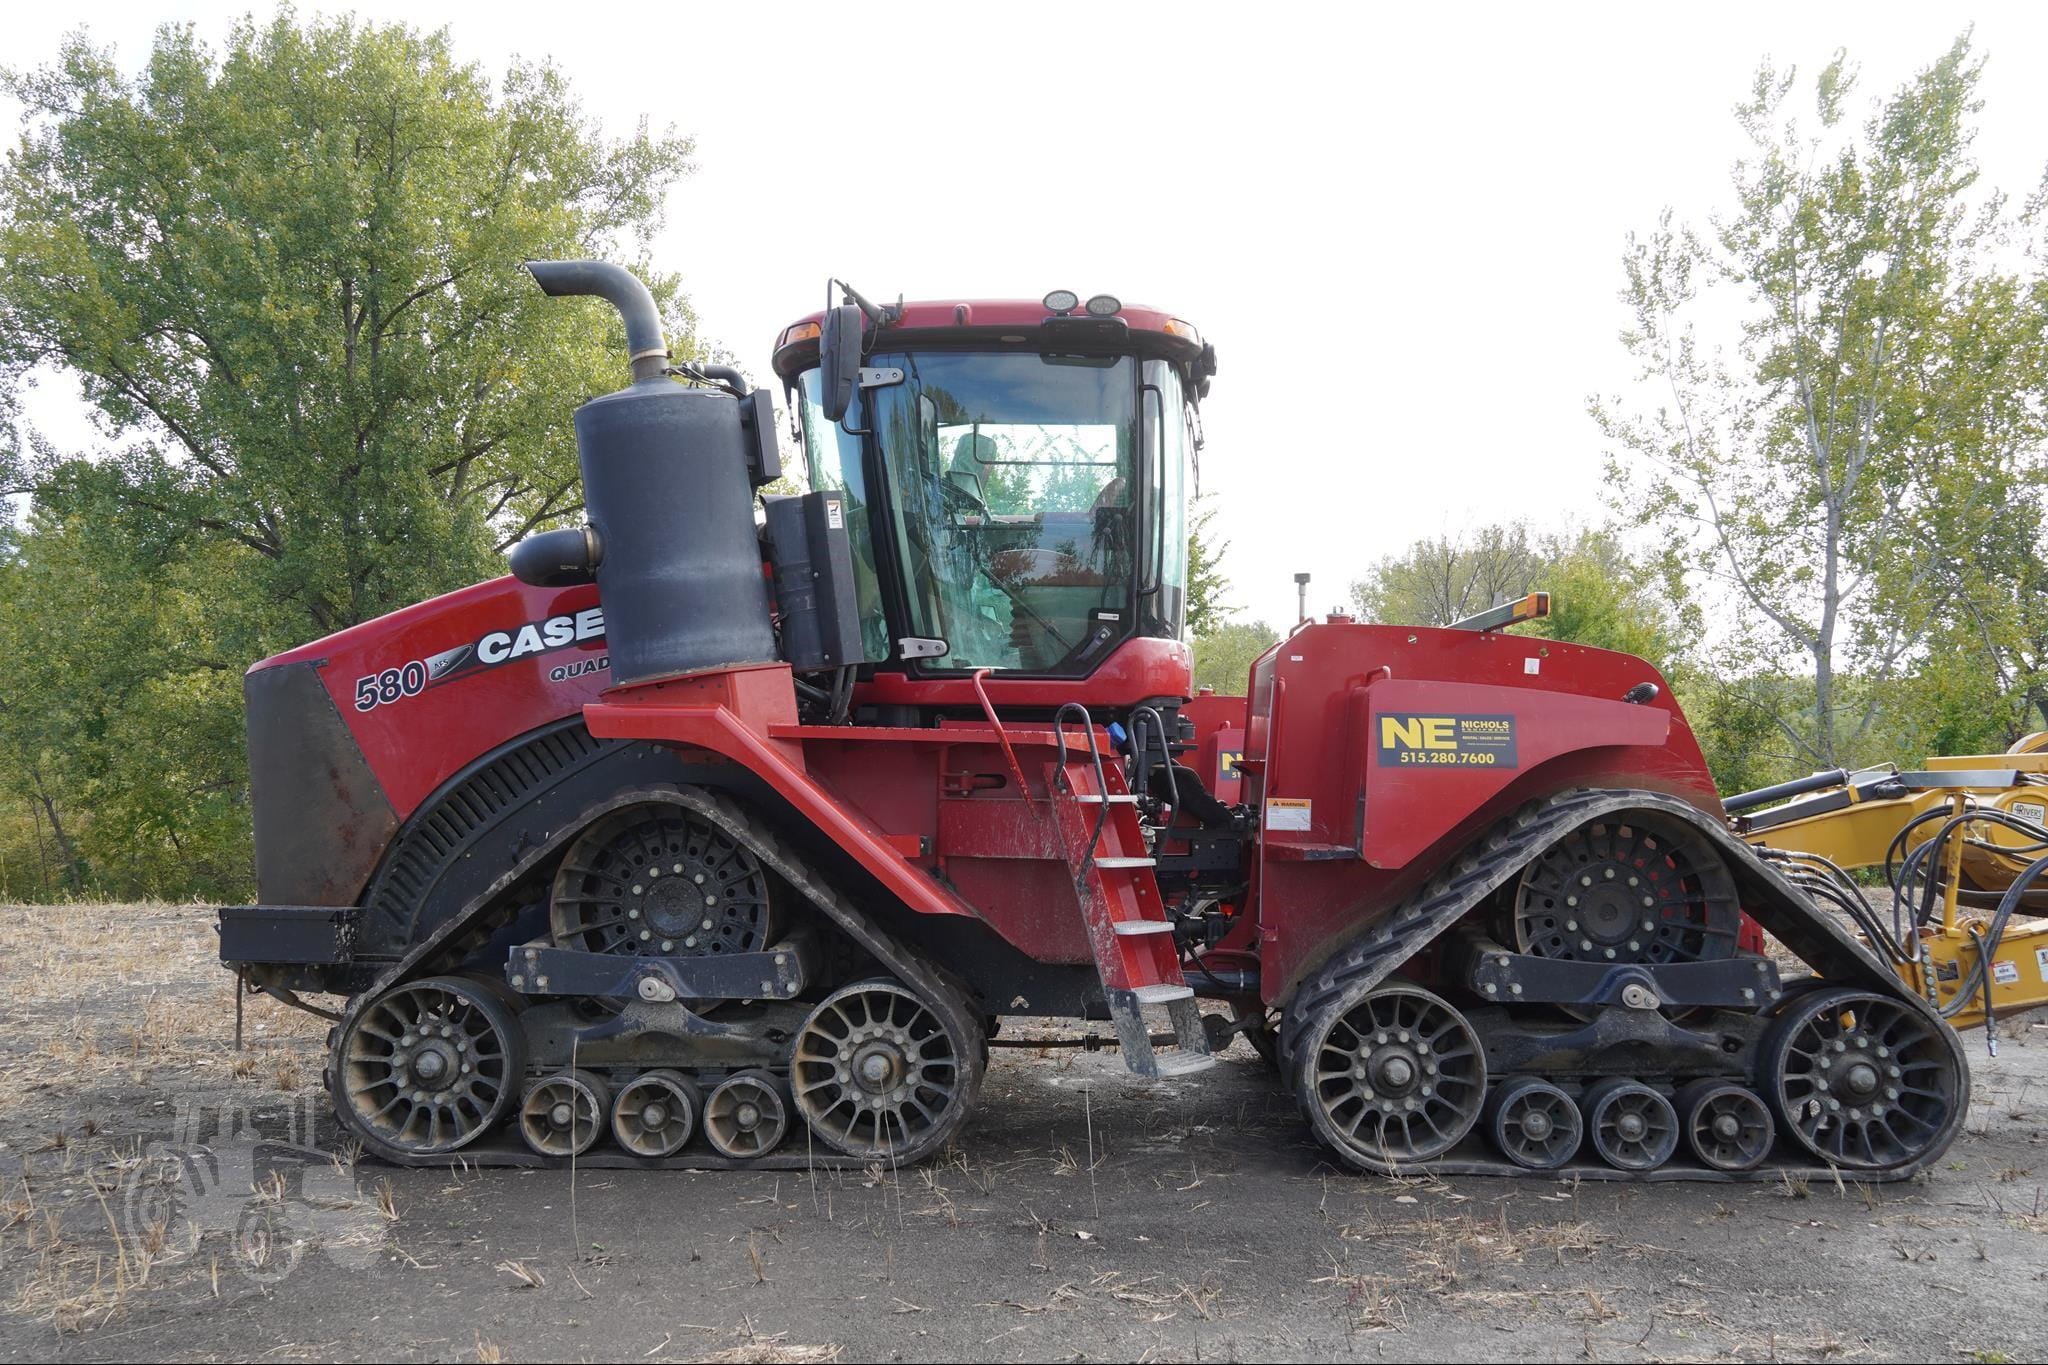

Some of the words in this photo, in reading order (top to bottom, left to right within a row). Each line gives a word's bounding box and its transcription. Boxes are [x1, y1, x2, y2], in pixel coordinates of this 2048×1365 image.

[477, 608, 606, 664] CASE
[354, 661, 426, 712] 580
[1381, 717, 1457, 749] NE
[1461, 720, 1509, 728] NICHOLS
[1400, 752, 1495, 764] 515.280.7600
